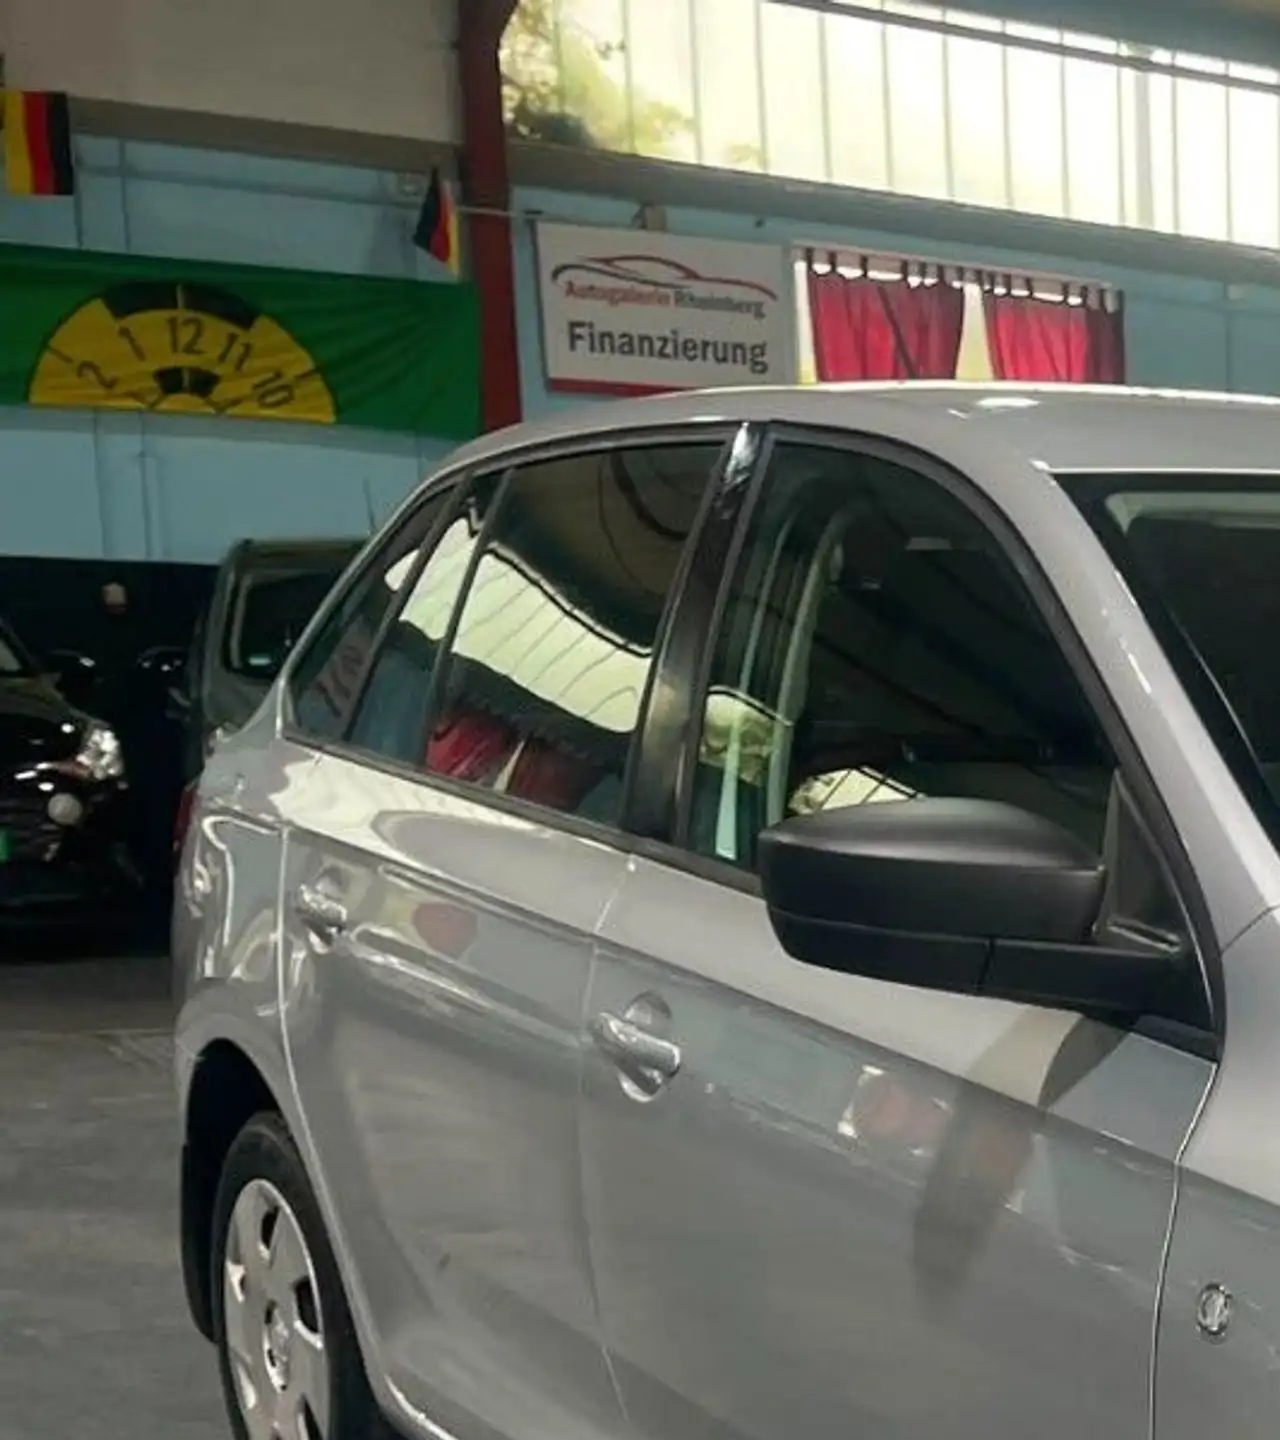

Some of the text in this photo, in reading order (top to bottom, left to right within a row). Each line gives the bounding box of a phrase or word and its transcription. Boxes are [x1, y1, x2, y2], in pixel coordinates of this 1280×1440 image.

[117, 326, 146, 362] 1
[166, 316, 205, 355] 12
[217, 331, 255, 371] 11
[251, 370, 295, 408] 10
[567, 320, 769, 374] Finanzierung
